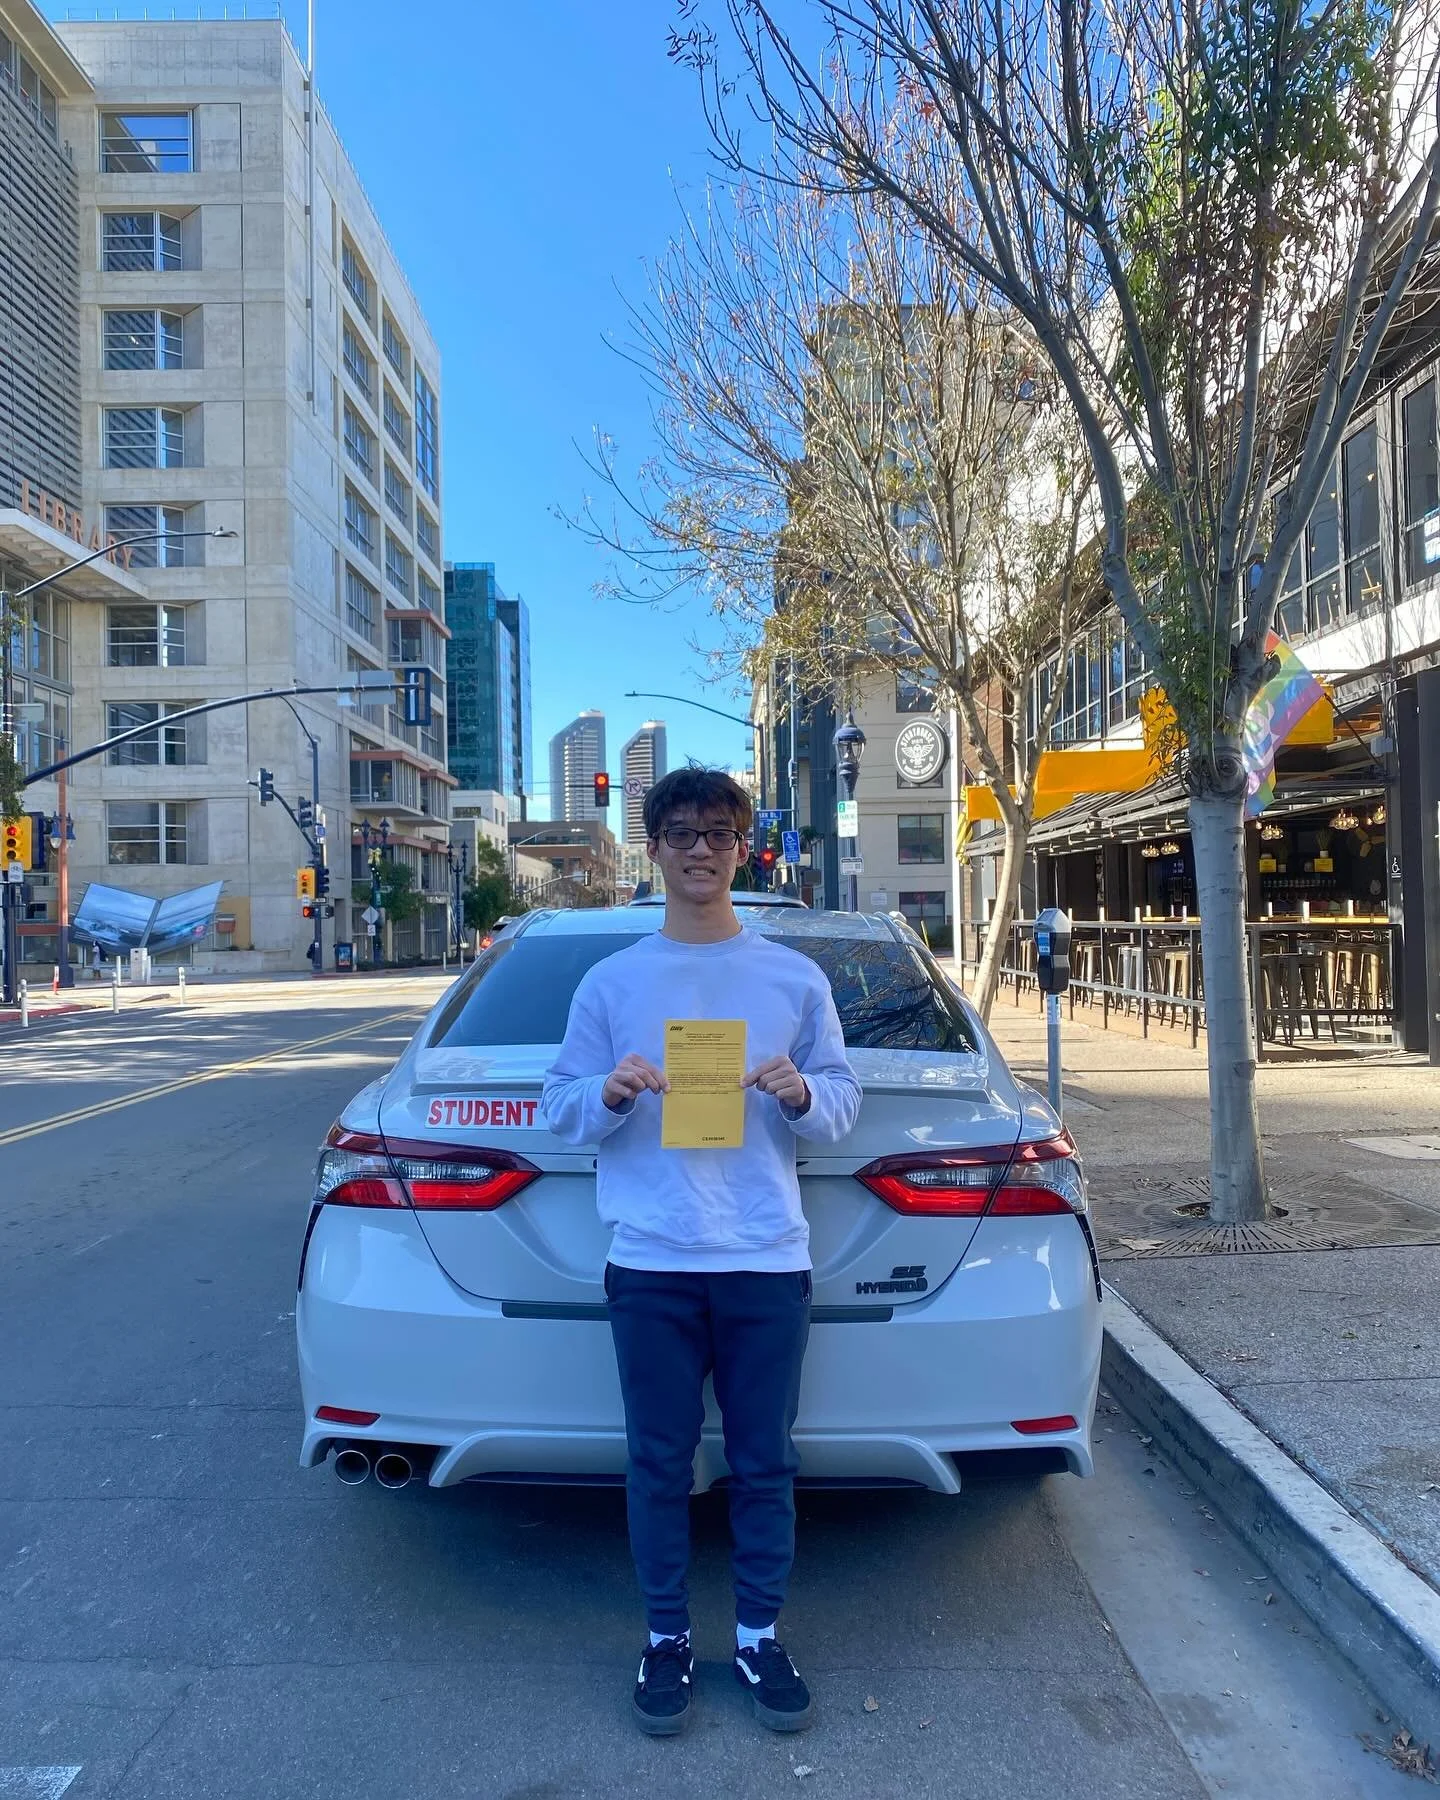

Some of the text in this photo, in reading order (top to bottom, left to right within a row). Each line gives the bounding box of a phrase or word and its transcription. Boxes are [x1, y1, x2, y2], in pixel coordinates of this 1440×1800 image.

[22, 479, 134, 571] LIBRARY
[428, 1100, 538, 1126] STUDENT
[890, 1265, 927, 1279] SE
[856, 1279, 919, 1294] HYBRID
